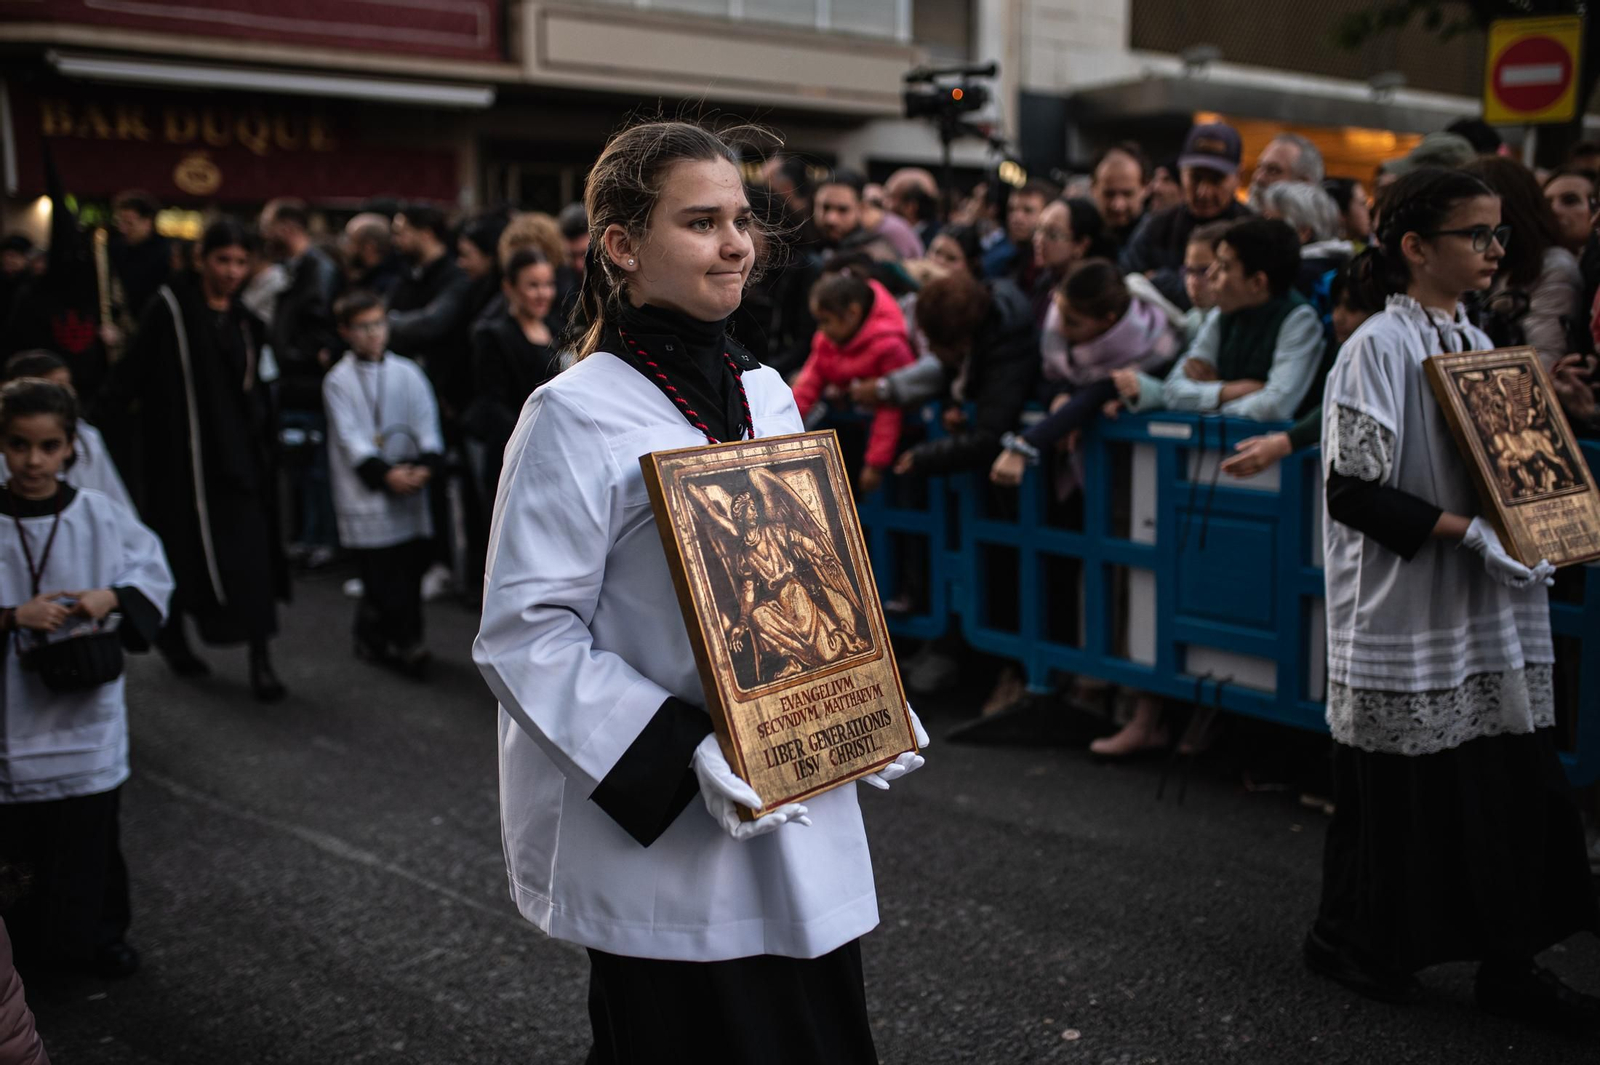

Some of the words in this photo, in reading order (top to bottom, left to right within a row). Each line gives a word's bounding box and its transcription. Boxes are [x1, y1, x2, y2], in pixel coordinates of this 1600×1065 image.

[40, 100, 149, 140] BAR
[757, 707, 819, 740] SECVNDVM
[824, 683, 884, 716] MATTHAEVM
[779, 676, 855, 712] EVANGELIVM
[763, 739, 806, 769] LIBER
[809, 708, 892, 752] GENERATIONIS
[794, 754, 821, 781] IESV
